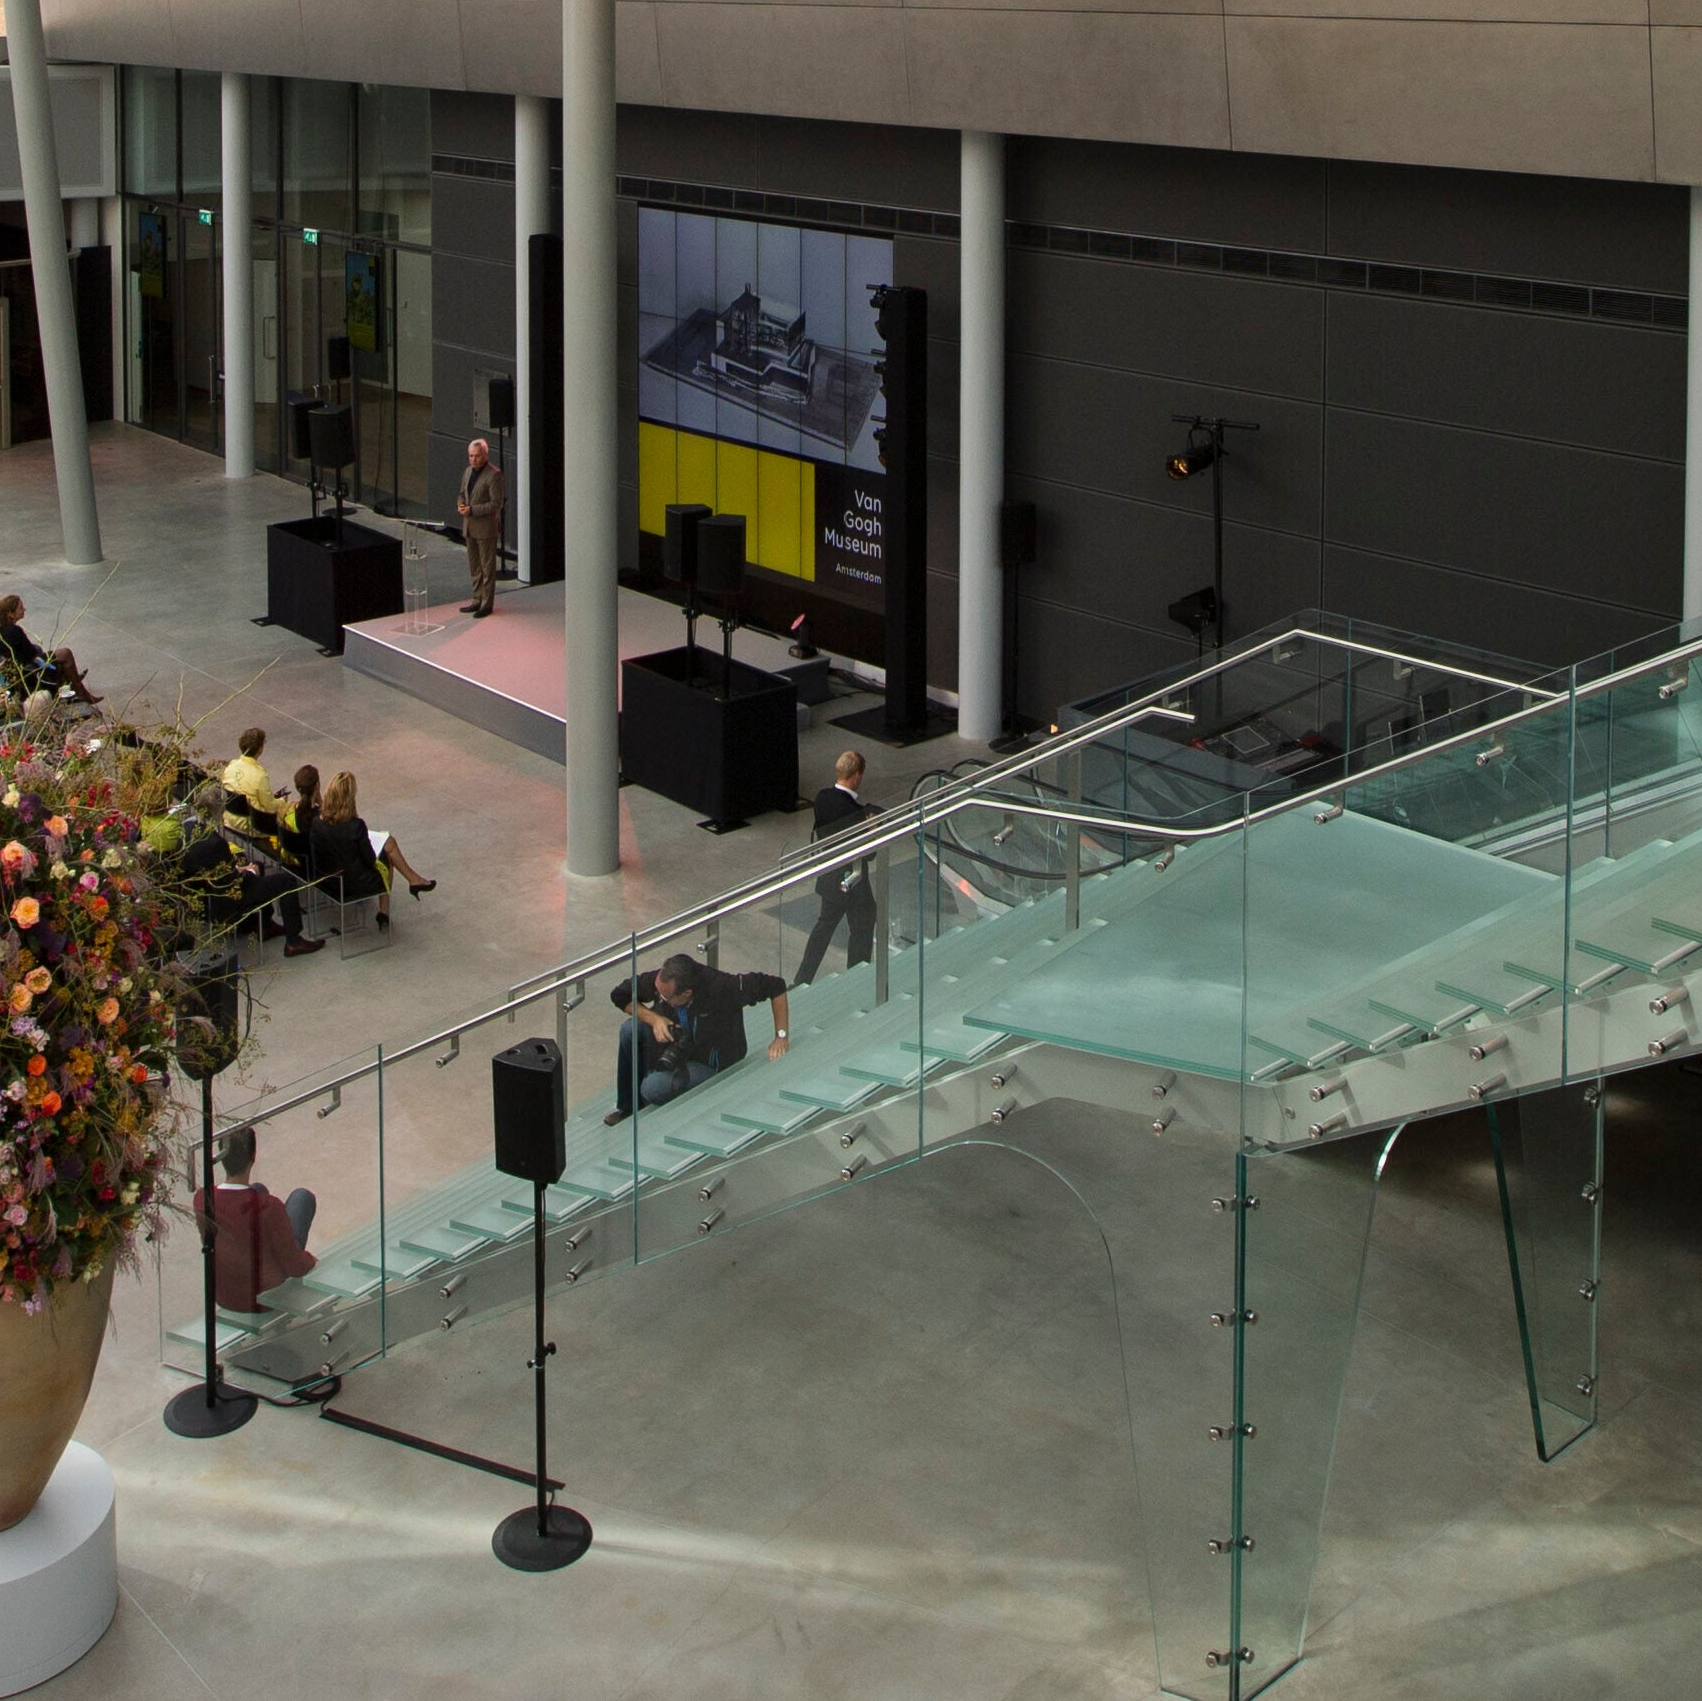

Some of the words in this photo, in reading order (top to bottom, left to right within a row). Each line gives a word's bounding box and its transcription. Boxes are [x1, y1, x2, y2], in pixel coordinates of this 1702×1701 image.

[854, 489, 882, 513] Van
[843, 510, 882, 537] Gogh
[824, 527, 882, 559] Museum
[835, 563, 882, 584] Amsterdam
